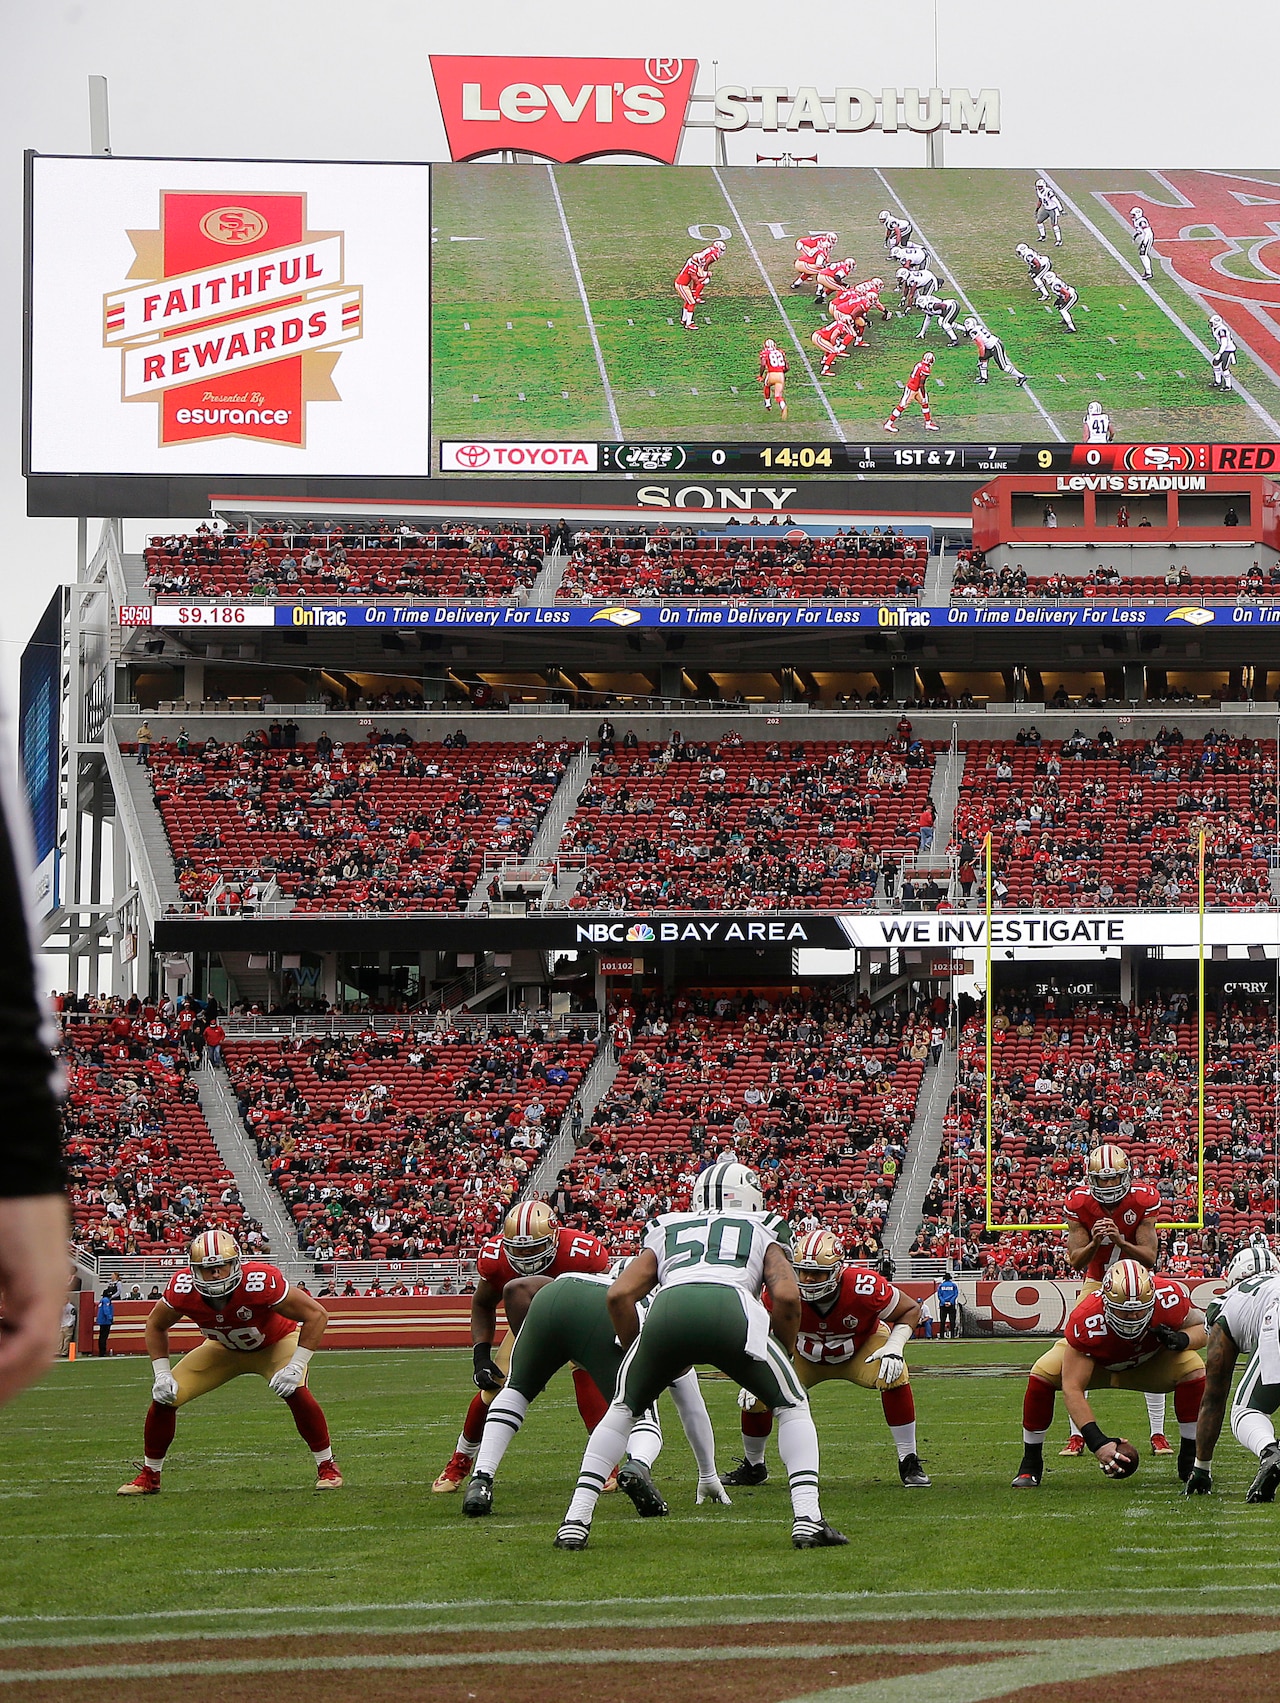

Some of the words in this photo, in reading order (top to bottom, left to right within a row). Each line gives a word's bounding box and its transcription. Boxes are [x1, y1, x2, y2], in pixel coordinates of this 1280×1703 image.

[715, 86, 1001, 135] STADIUM
[144, 254, 323, 322] FAITHFUL
[144, 311, 327, 383] REWARDS
[202, 391, 248, 403] Presented
[251, 391, 265, 406] By
[176, 408, 289, 425] esurance
[1092, 419, 1107, 433] 41
[494, 449, 588, 466] TOYOTA
[711, 449, 726, 466] 0
[760, 448, 832, 467] 14:04
[863, 447, 871, 461] 1
[894, 450, 924, 465] 1ST
[928, 450, 942, 465] &
[945, 450, 955, 465] 7
[987, 447, 997, 460] 7
[1038, 450, 1052, 468] 9
[1086, 450, 1100, 466] 0
[1219, 448, 1274, 469] RED
[858, 461, 876, 469] QTR
[989, 462, 1007, 470] LINE
[1128, 475, 1206, 491] STADIUM
[637, 485, 797, 510] SONY
[179, 607, 245, 624] $9,186
[293, 610, 347, 626] OnTrac
[365, 608, 389, 623] On
[393, 608, 431, 623] Time
[435, 608, 500, 626] Delivery
[504, 608, 531, 623] For
[535, 608, 570, 623] Less
[659, 608, 682, 624] On
[685, 608, 722, 624] Time
[726, 608, 792, 627] Delivery
[795, 608, 821, 624] For
[825, 608, 861, 624] Less
[878, 610, 930, 626] OnTrac
[948, 608, 970, 624] On
[974, 608, 1011, 624] Time
[1014, 608, 1078, 627] Delivery
[1082, 608, 1108, 624] For
[1112, 608, 1146, 624] Less
[1232, 607, 1253, 622] On
[360, 718, 372, 726] 201
[576, 923, 624, 943] NBC
[660, 922, 720, 941] BAY
[725, 922, 809, 941] AREA
[880, 920, 931, 943] WE
[938, 919, 1125, 942] INVESTIGATE
[601, 962, 616, 971] 101
[618, 961, 633, 971] 102
[933, 963, 948, 971] 102
[481, 1240, 501, 1260] 77
[569, 1236, 595, 1257] 77
[664, 1217, 755, 1271] 50
[160, 1259, 173, 1267] 146
[389, 1262, 403, 1270] 101
[174, 1273, 194, 1294] 88
[244, 1271, 267, 1292] 88
[855, 1273, 877, 1296] 65
[1157, 1284, 1181, 1310] 67
[1085, 1314, 1108, 1338] 67
